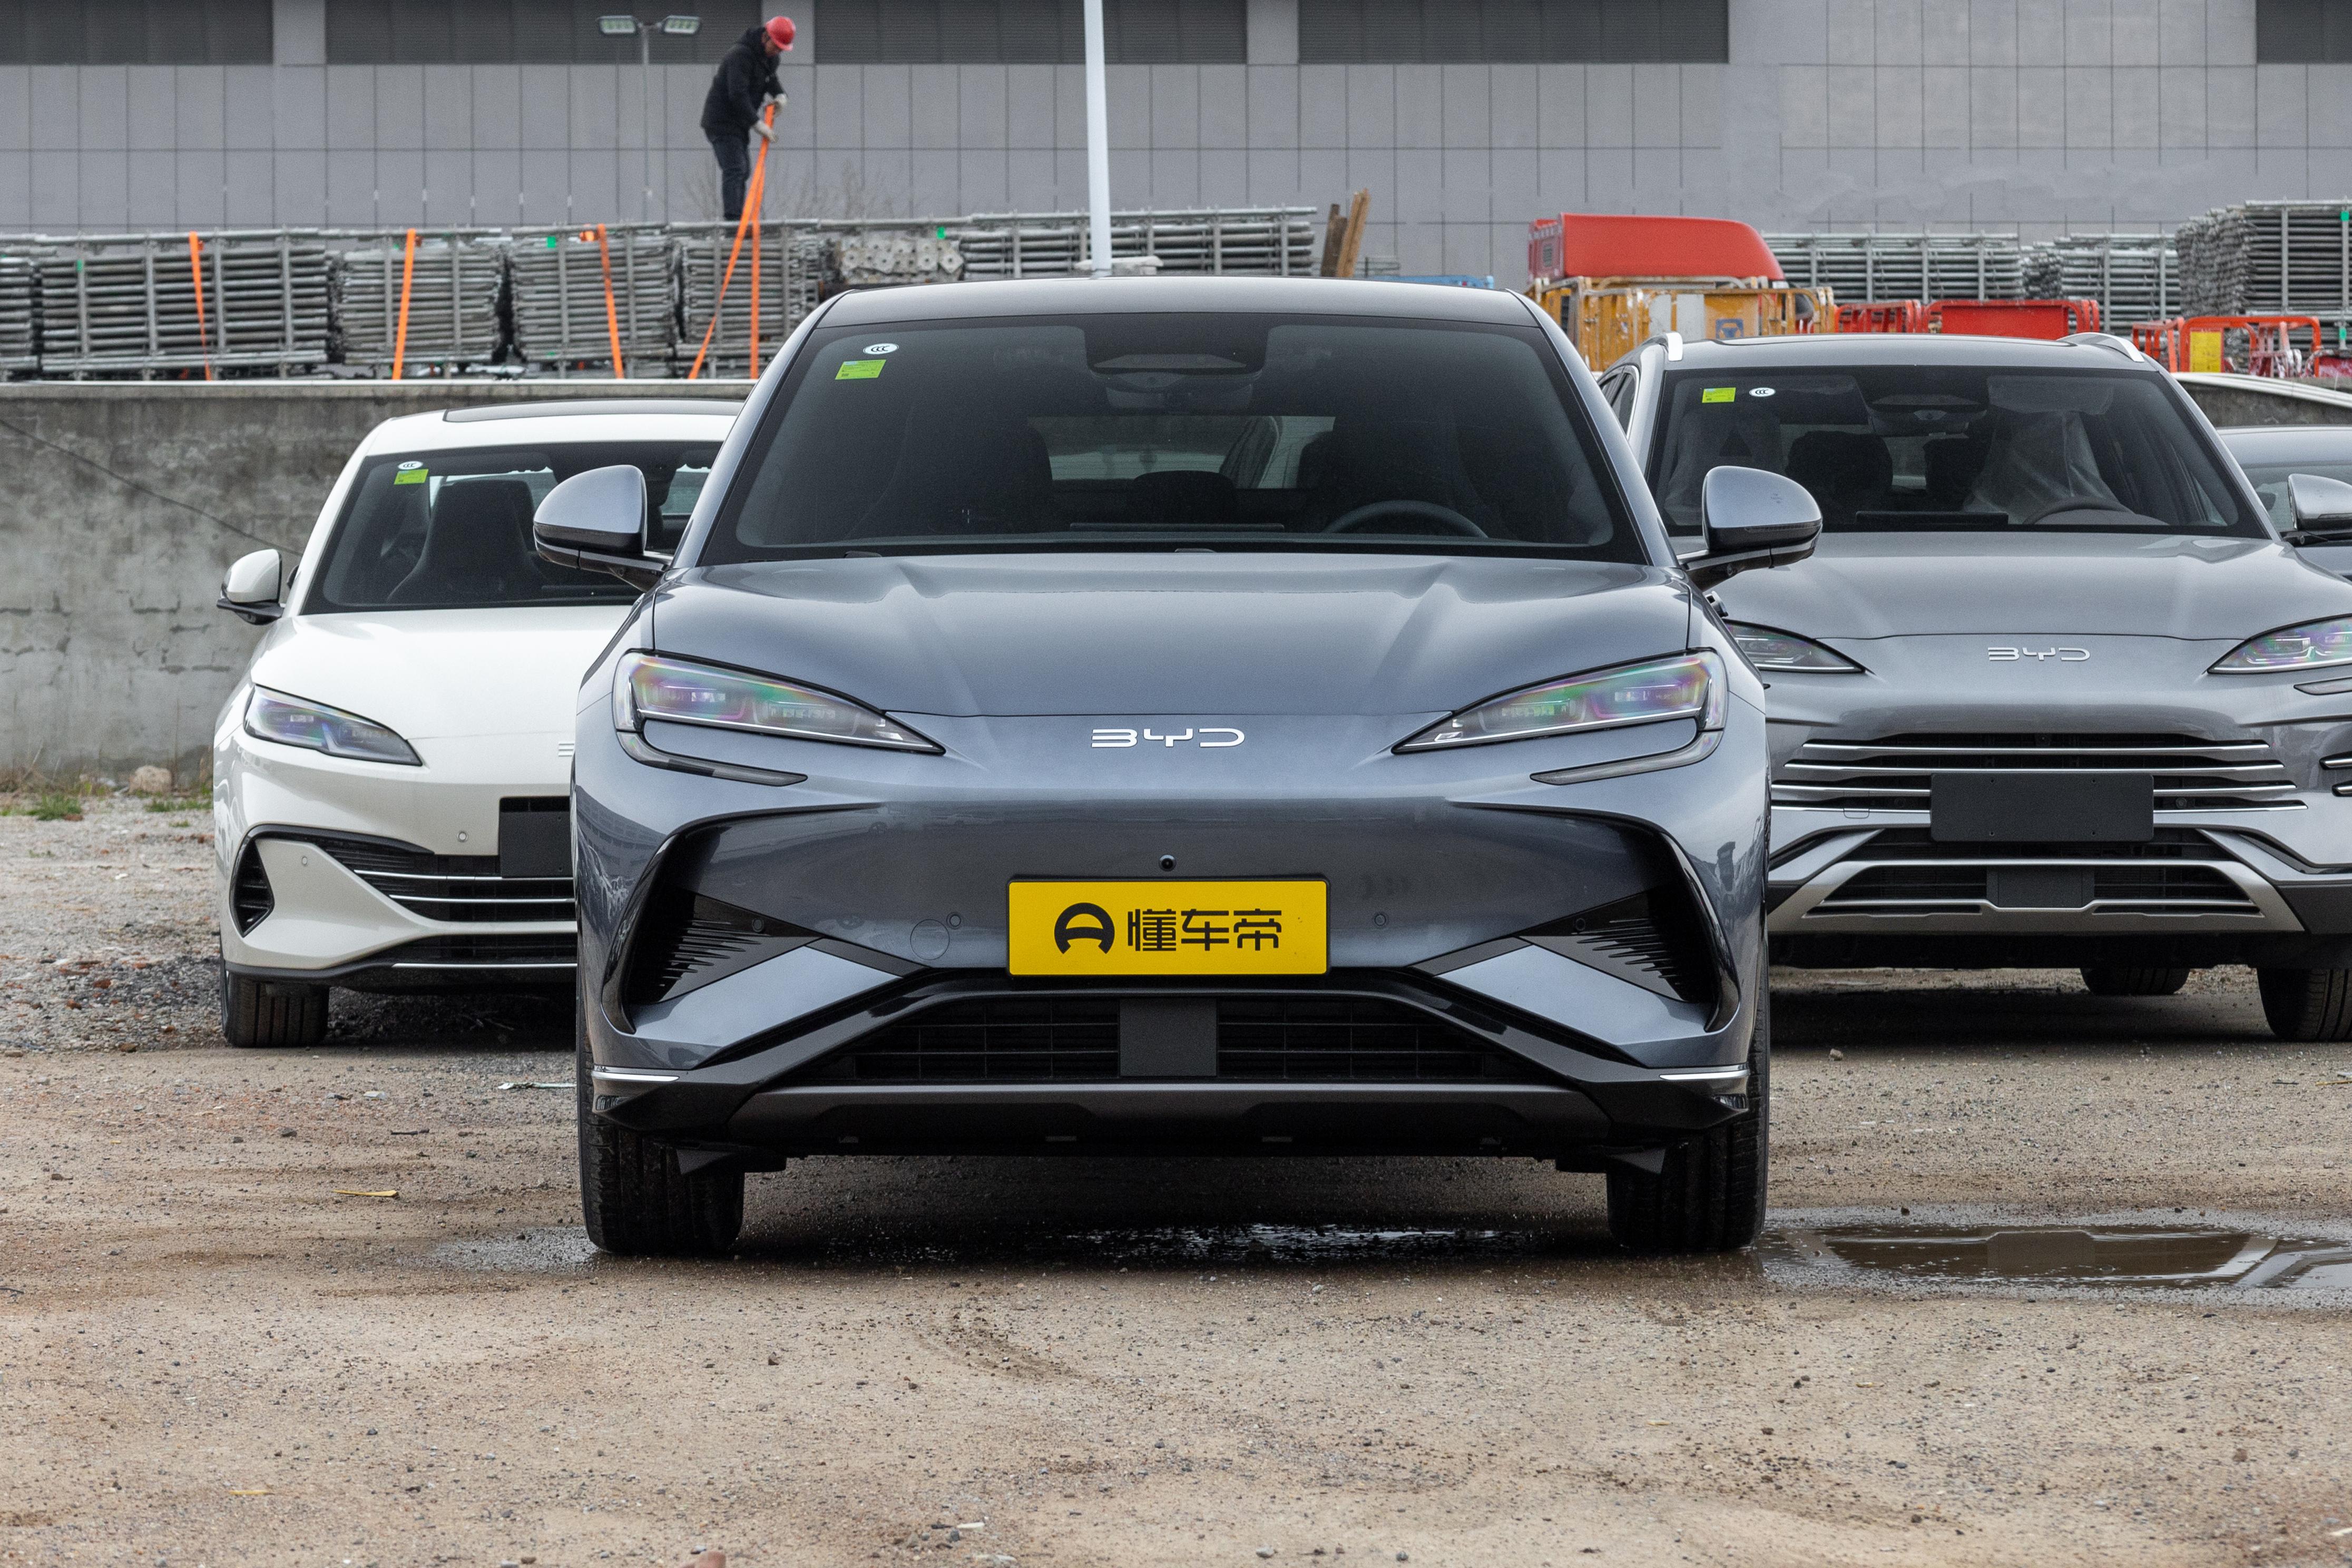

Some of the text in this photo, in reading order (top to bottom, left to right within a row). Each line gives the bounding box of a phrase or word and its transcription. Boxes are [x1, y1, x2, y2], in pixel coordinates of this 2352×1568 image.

[1987, 646, 2091, 661] BYD
[1091, 728, 1246, 748] BYD
[1128, 908, 1282, 952] 懂车帝
